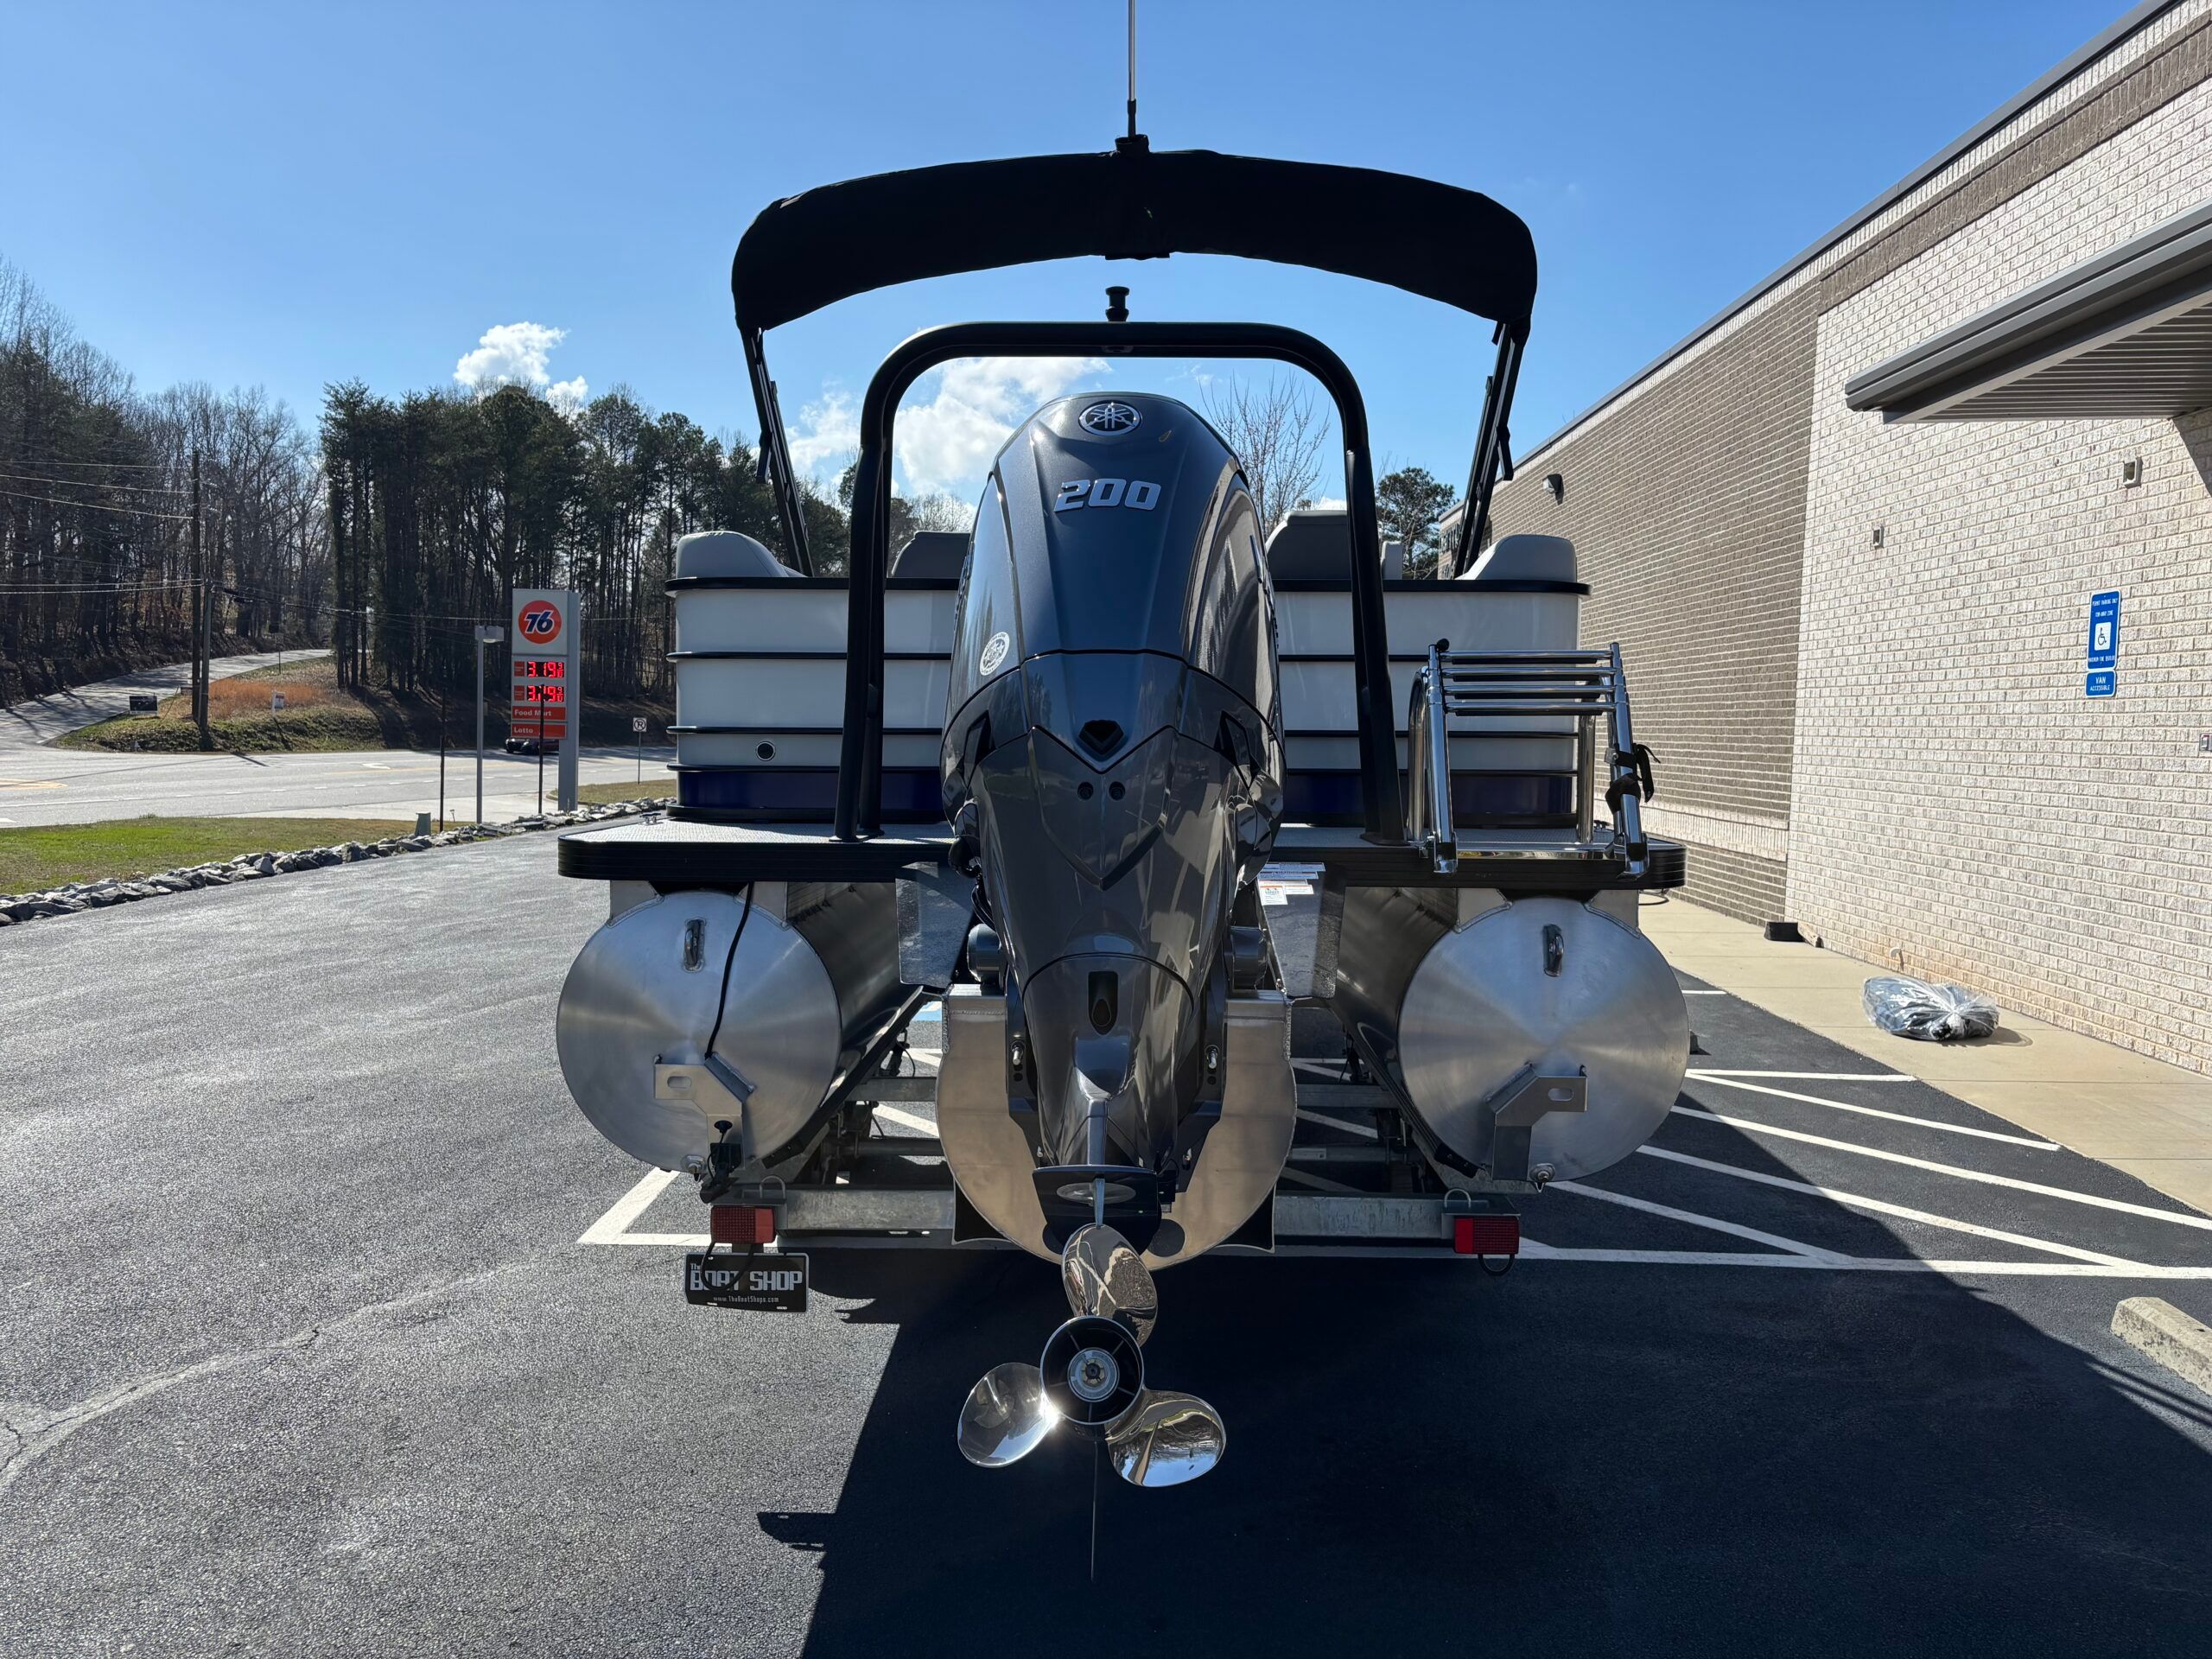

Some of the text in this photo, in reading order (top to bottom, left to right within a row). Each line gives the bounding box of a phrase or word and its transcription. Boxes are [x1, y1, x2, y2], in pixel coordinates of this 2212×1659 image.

[1053, 478, 1162, 512] 200
[524, 610, 555, 634] 76
[527, 661, 556, 678] 3.19
[2095, 676, 2107, 684] VAN
[749, 1270, 803, 1291] SHOP
